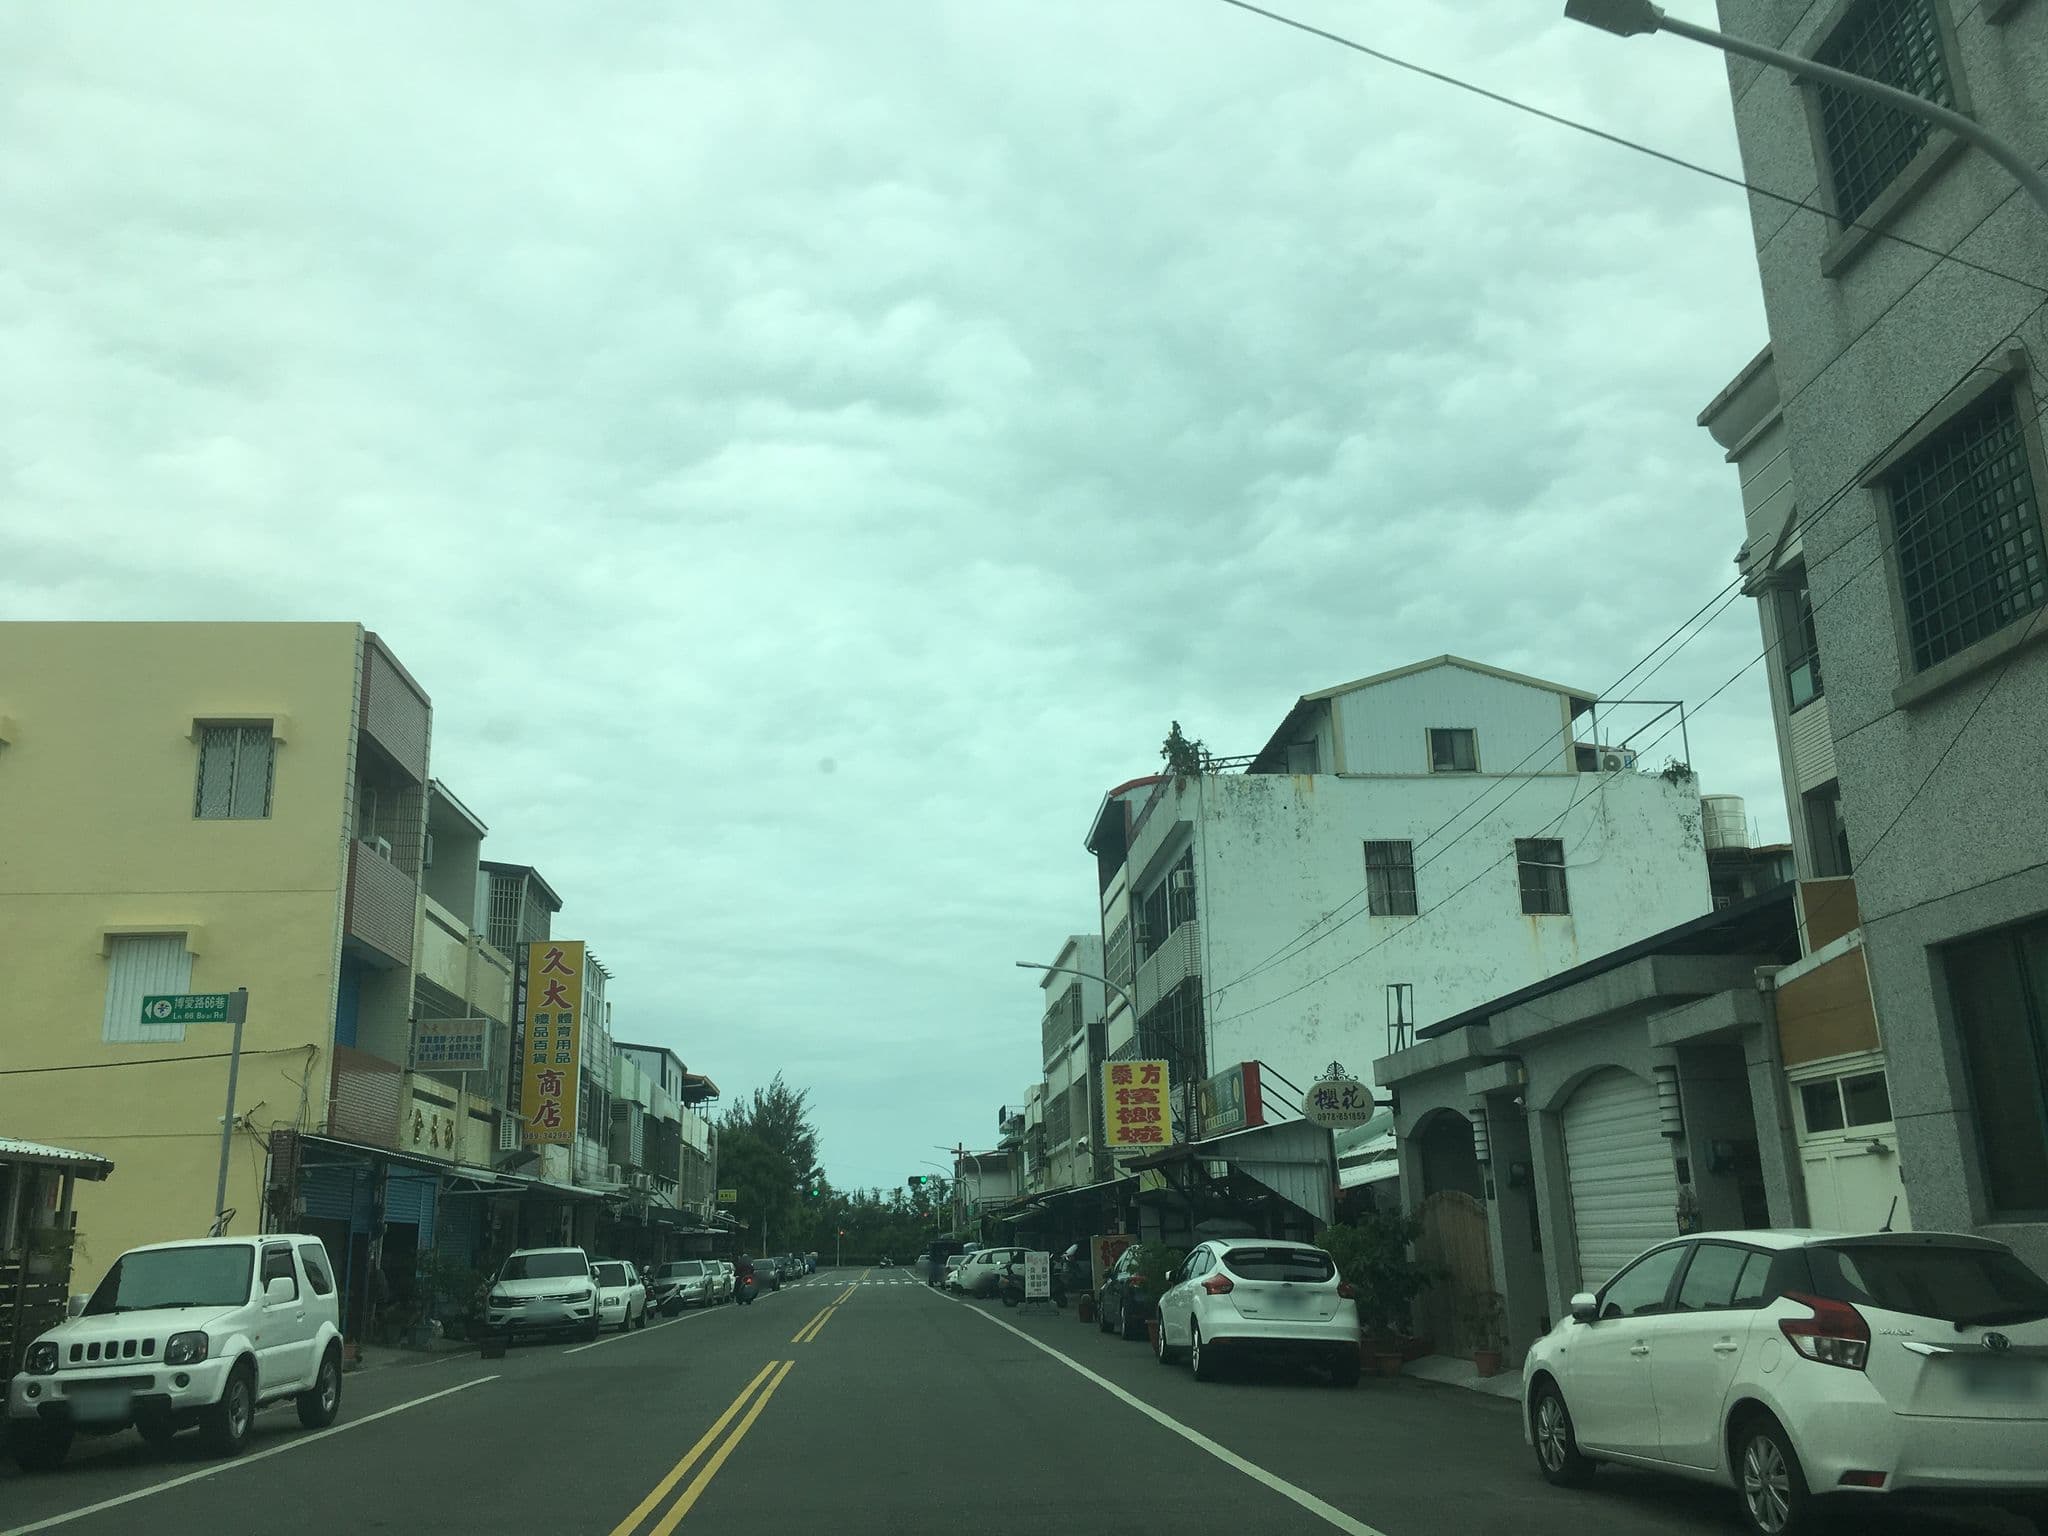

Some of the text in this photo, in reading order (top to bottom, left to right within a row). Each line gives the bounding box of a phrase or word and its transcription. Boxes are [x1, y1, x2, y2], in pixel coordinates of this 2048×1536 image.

[174, 996, 225, 1009] 博愛路66巷
[540, 946, 576, 1009] 久大
[532, 1013, 550, 1065] 禮品百貨
[555, 1012, 573, 1064] 體育用品
[531, 1069, 566, 1128] 商店
[1314, 1085, 1366, 1110] 櫻花
